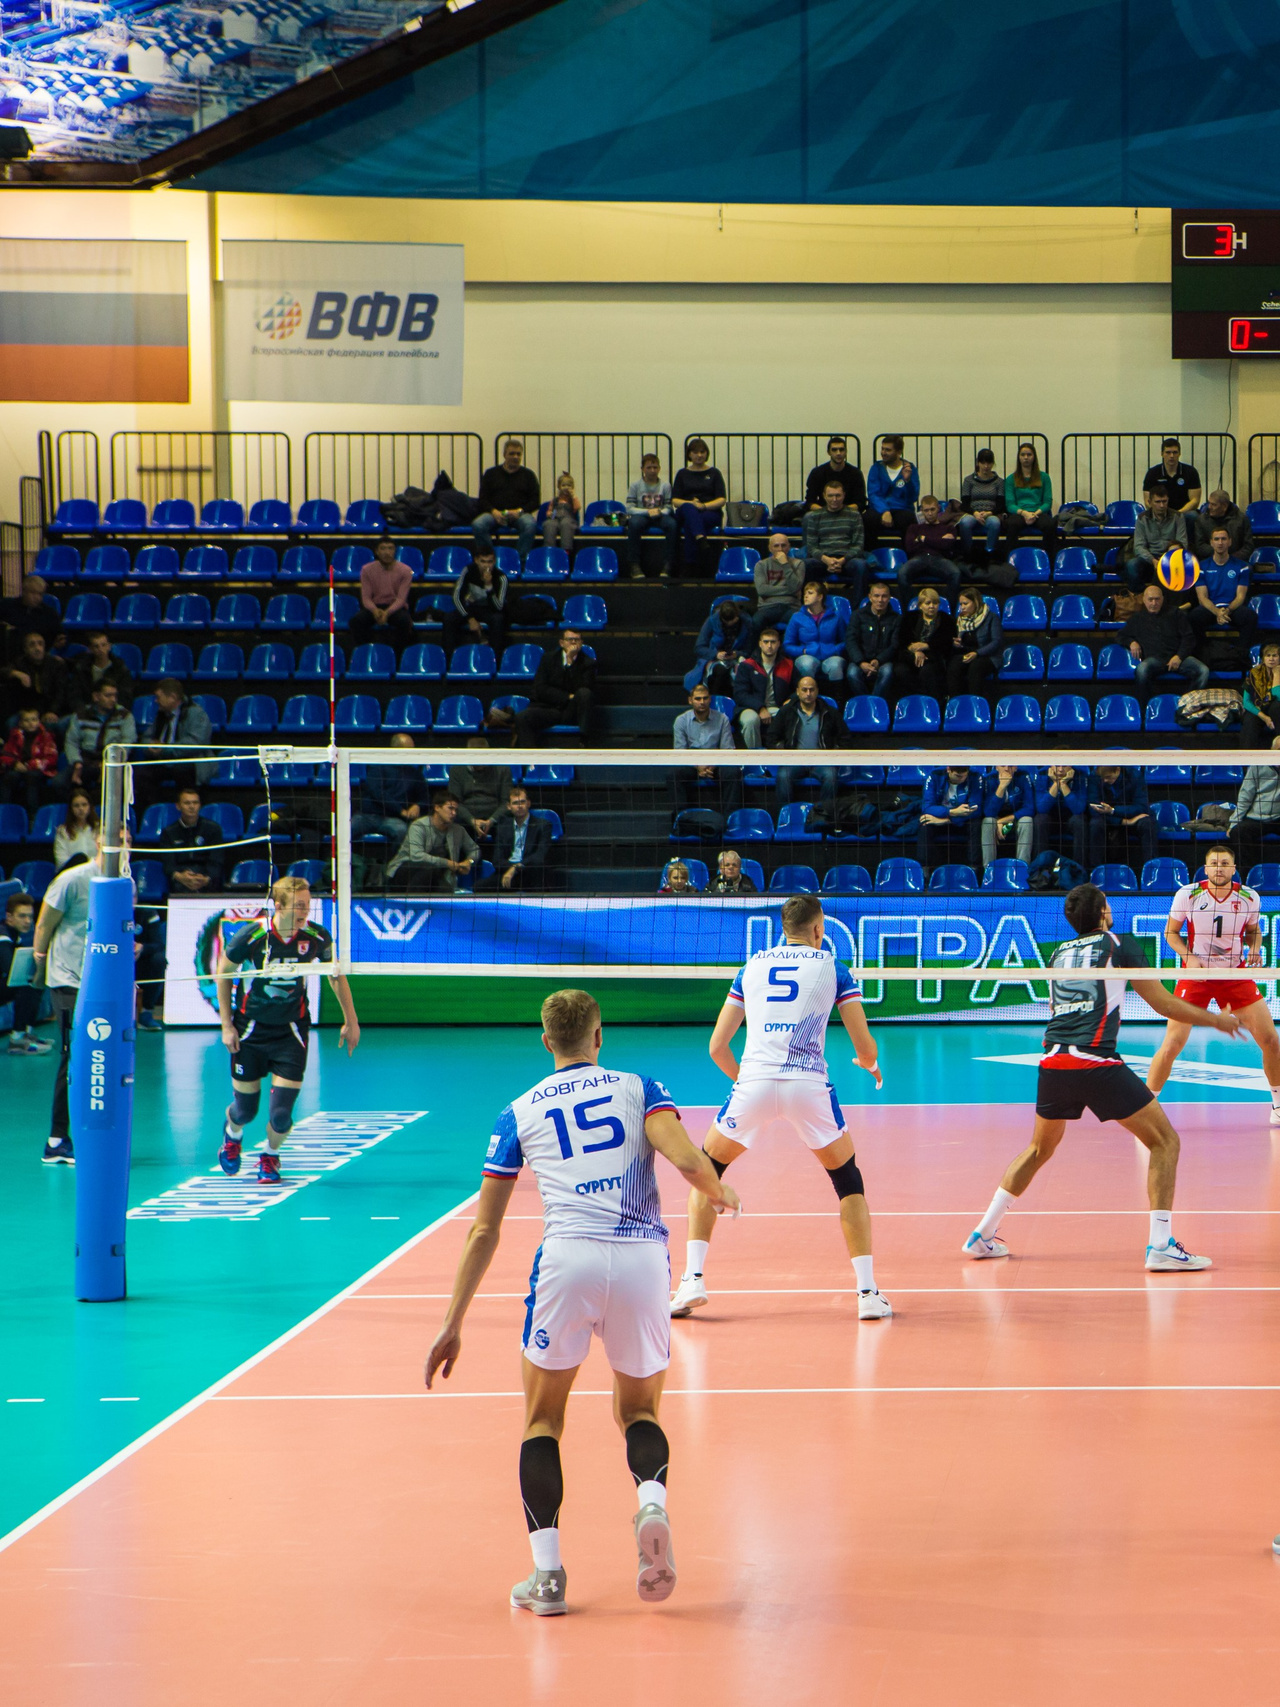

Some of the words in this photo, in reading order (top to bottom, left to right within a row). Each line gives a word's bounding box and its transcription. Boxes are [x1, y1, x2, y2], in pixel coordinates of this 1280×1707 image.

[1214, 226, 1233, 256] 3
[1232, 232, 1248, 249] H
[306, 291, 440, 341] ВФВ
[327, 346, 384, 359] федерация
[387, 348, 440, 359] волейбола
[1213, 915, 1223, 938] 1
[766, 966, 800, 1003] 5
[764, 1022, 798, 1033] СУРГУТ
[530, 1074, 620, 1105] ДОВГАНЬ
[544, 1095, 626, 1161] 15
[575, 1176, 623, 1195] СУРГУТ
